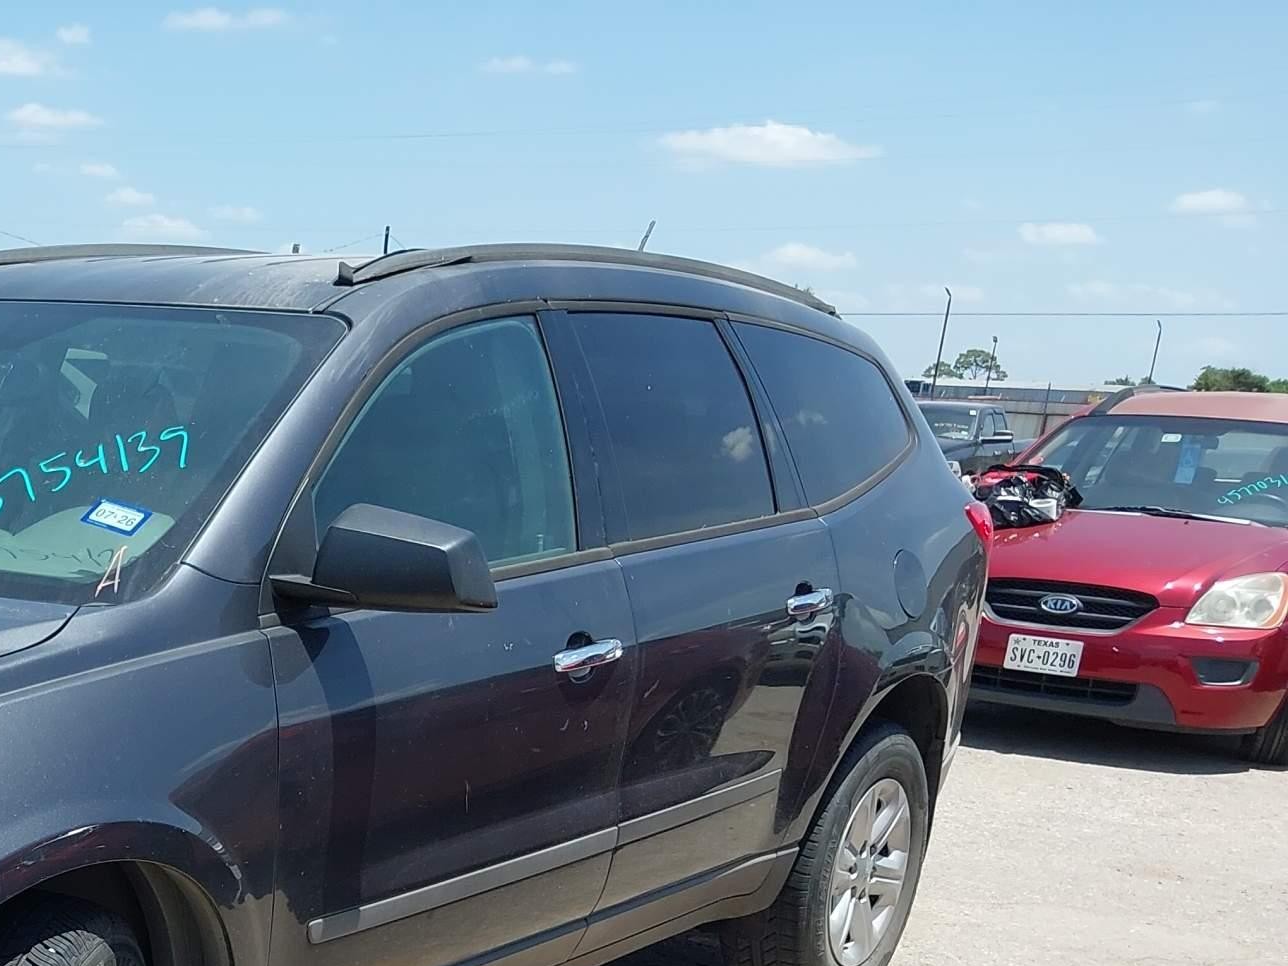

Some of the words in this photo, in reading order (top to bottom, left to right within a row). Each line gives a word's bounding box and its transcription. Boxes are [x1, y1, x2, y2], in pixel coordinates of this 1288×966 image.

[94, 545, 128, 598] A
[1046, 599, 1072, 610] KIA
[1031, 639, 1060, 649] TEXAS
